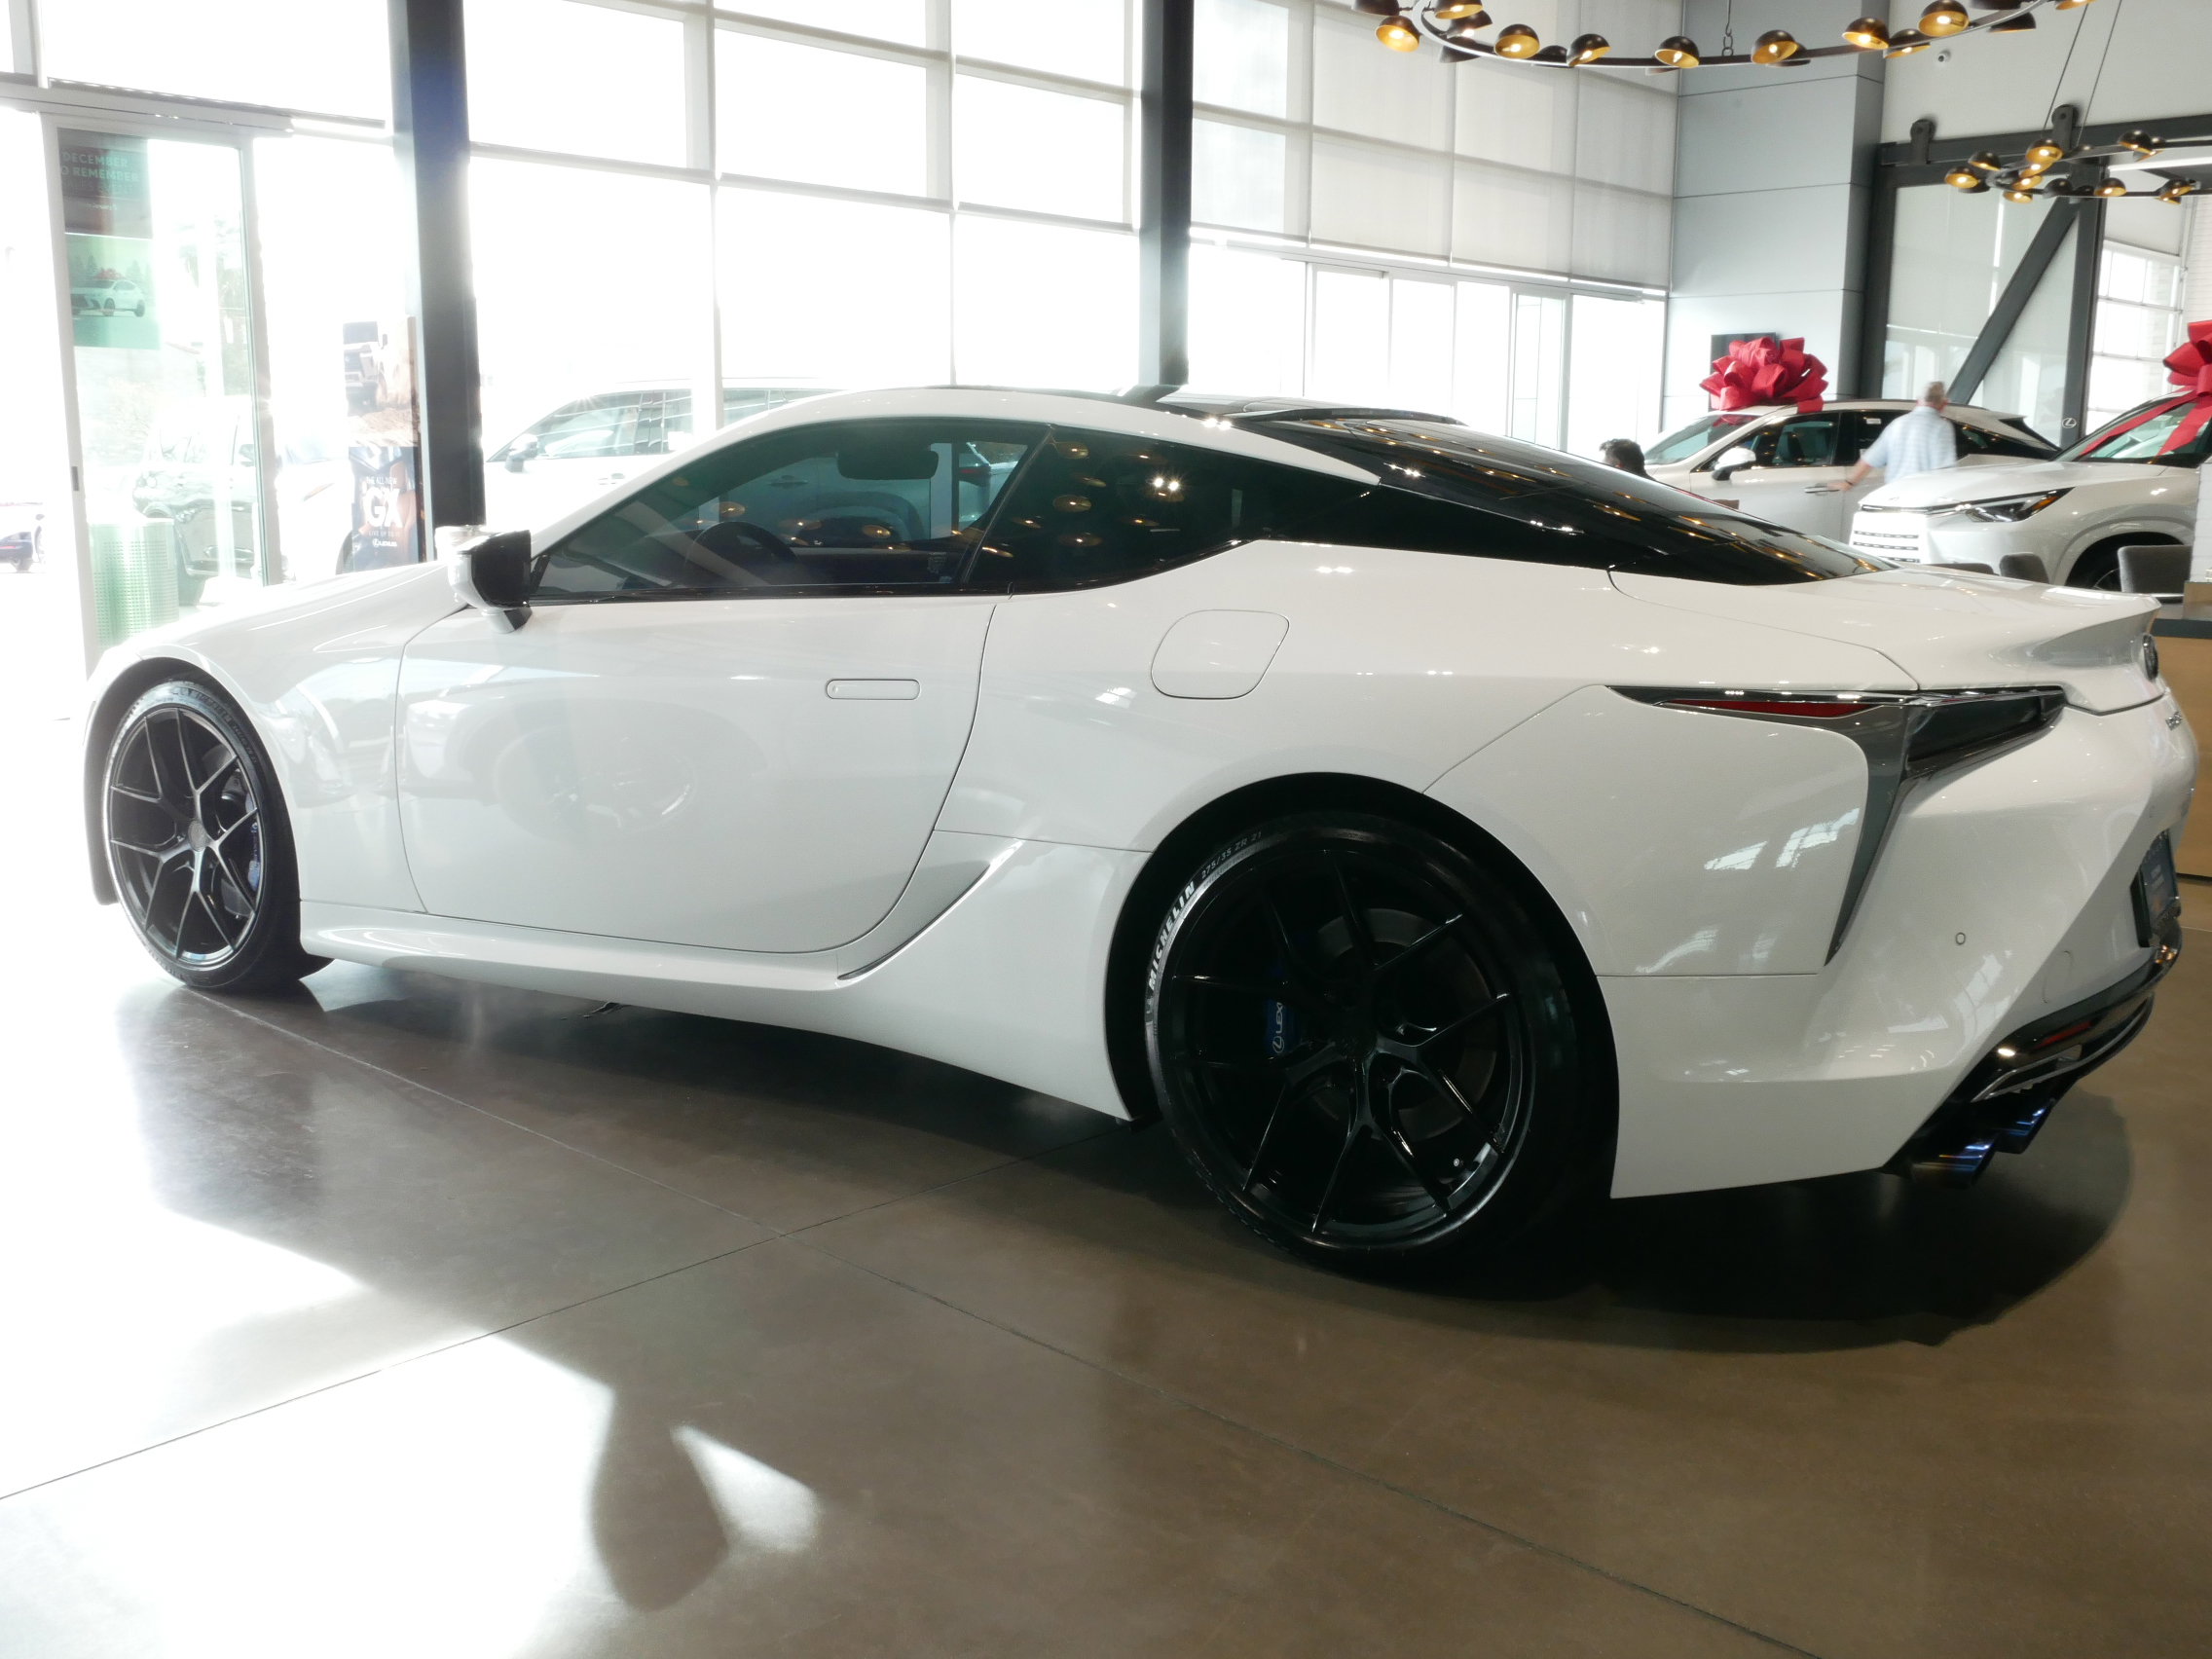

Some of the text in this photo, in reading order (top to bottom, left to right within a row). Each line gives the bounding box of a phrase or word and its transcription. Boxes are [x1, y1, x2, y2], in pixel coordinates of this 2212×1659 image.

[61, 151, 128, 167] DECEMBER
[73, 166, 139, 182] REMEMBER
[363, 487, 403, 528] GX
[1148, 831, 1262, 991] MICHELIN 275/35 ZR 21
